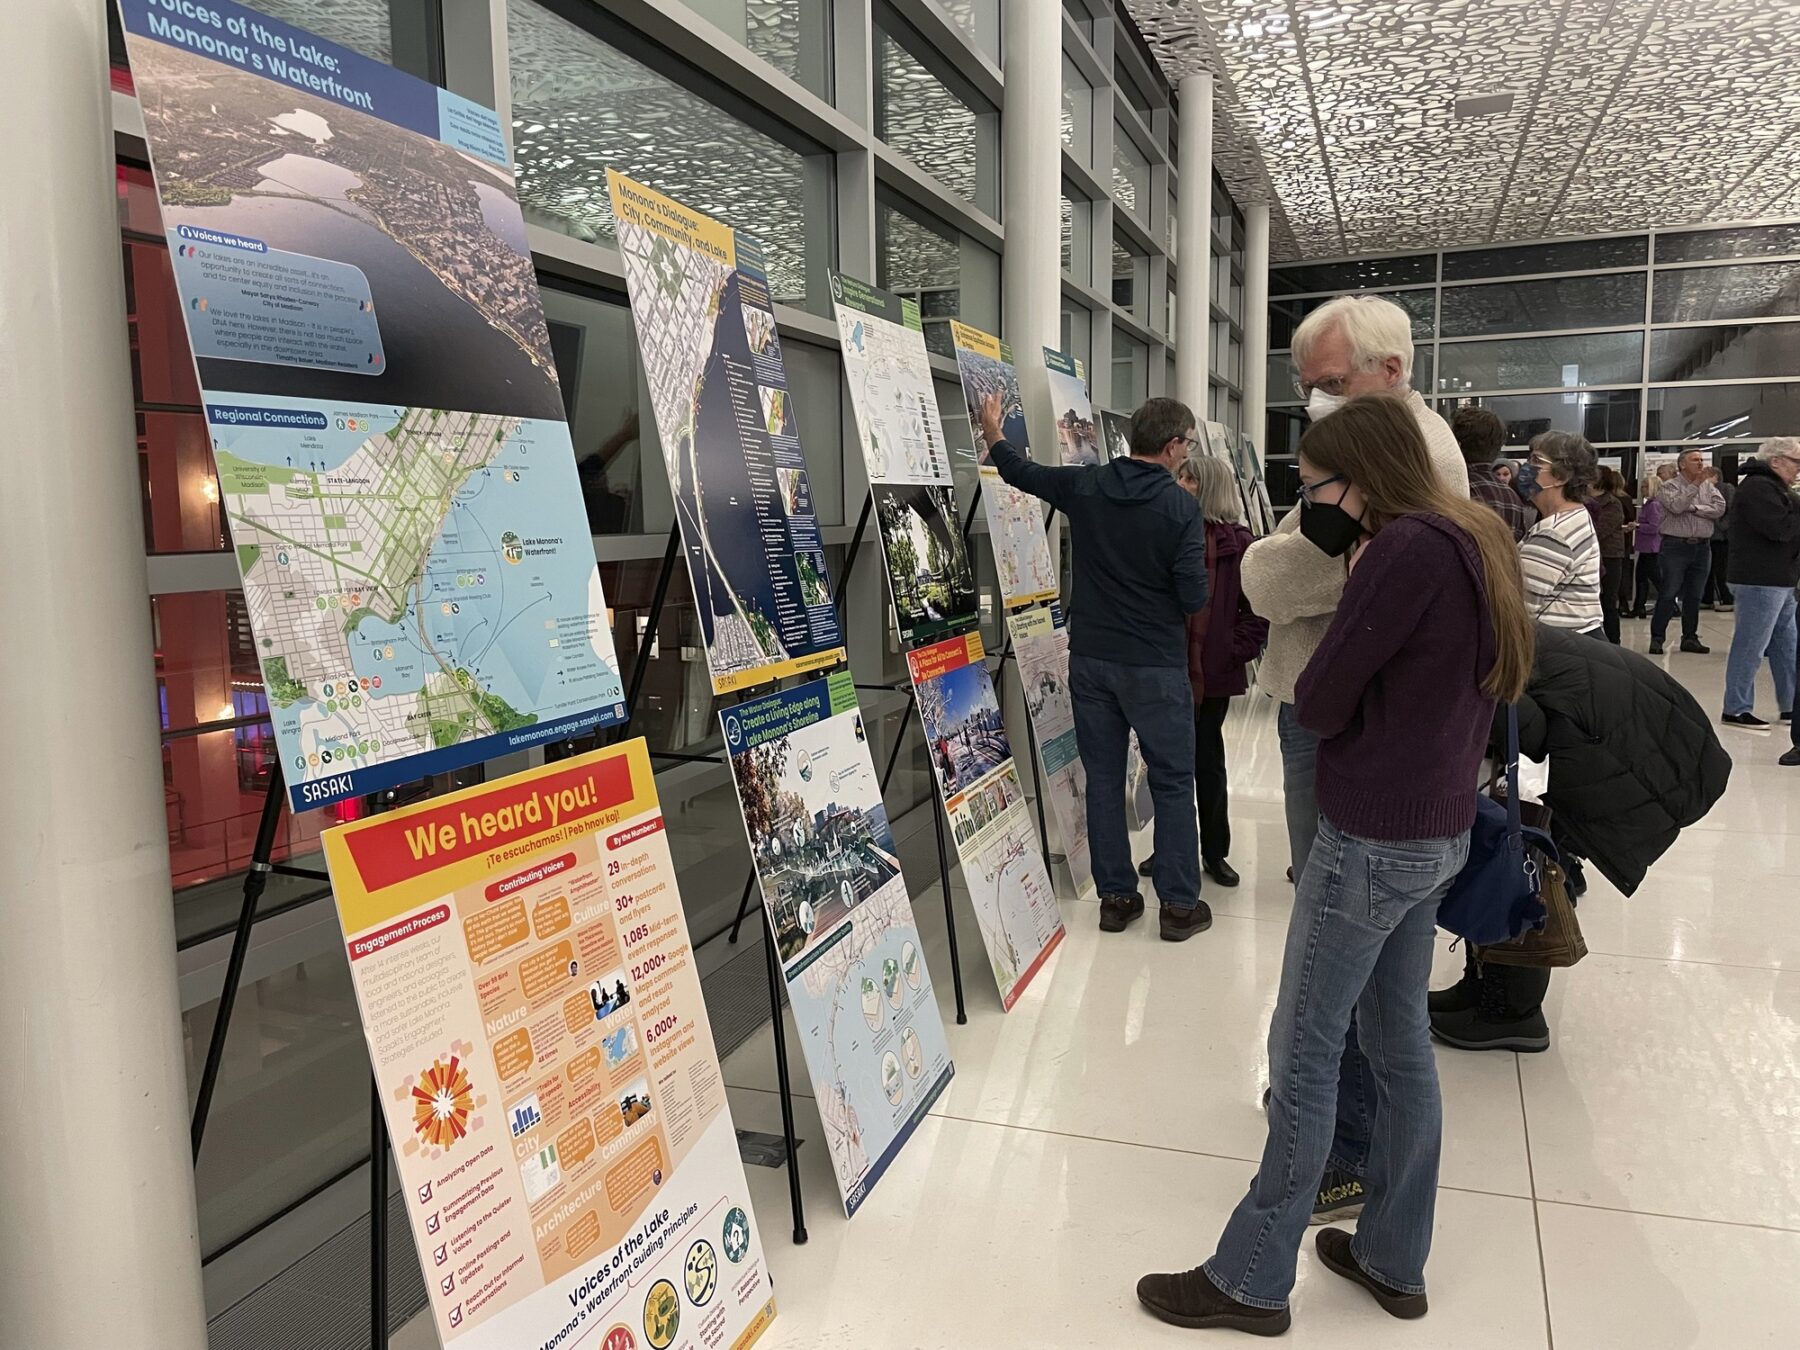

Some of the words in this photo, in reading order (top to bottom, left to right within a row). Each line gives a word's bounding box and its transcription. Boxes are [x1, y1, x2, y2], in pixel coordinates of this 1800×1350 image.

[148, 0, 222, 29] oices
[227, 17, 247, 37] of
[251, 23, 286, 53] the
[289, 38, 341, 73] Lake:
[147, 12, 263, 70] Monona's
[265, 54, 374, 111] Waterfront
[619, 183, 661, 214] Monona's
[191, 230, 222, 243] Voices
[223, 237, 237, 246] we
[238, 238, 263, 250] heard
[623, 203, 644, 225] City,
[645, 213, 695, 250] Community,
[696, 237, 709, 251] and
[710, 243, 728, 260] Lake
[215, 410, 261, 422] Regional
[264, 413, 325, 425] Connections
[509, 711, 614, 745] lakemonona.engage.sasaki.com
[742, 708, 765, 731] Create
[766, 715, 770, 723] a
[771, 706, 790, 721] Living
[789, 701, 803, 718] Edge
[804, 696, 820, 708] along
[746, 731, 762, 747] Lake
[762, 721, 793, 741] Monona's
[793, 712, 819, 730] Shoreline
[303, 775, 353, 802] SASAKI
[405, 823, 457, 860] We
[460, 792, 542, 844] heard
[544, 776, 598, 827] you!
[614, 838, 621, 846] By
[622, 833, 631, 841] the
[632, 822, 657, 838] Numbers!
[487, 852, 502, 870] ¡Te
[503, 832, 564, 860] escuchamos!
[568, 822, 584, 837] Peb
[585, 816, 604, 832] hnov
[605, 810, 620, 826] koj!
[499, 870, 543, 893] Contributing
[543, 860, 565, 874] Voices
[608, 861, 620, 876] 29
[621, 852, 649, 870] In-depth
[612, 862, 656, 889] conversations
[574, 900, 609, 924] Culture
[616, 895, 633, 911] 30+
[635, 882, 665, 904] postcards
[620, 913, 632, 925] and
[633, 904, 651, 920] flyers
[623, 924, 648, 948] 1,085
[650, 913, 678, 933] Mid-term
[355, 923, 412, 954] Engagement
[412, 910, 445, 928] Process
[628, 946, 645, 960] event
[646, 927, 677, 953] responses
[631, 953, 666, 981] 12,000+
[668, 944, 689, 960] Google
[635, 980, 653, 996] Maps
[654, 960, 686, 984] comments
[639, 993, 651, 1008] and
[652, 981, 673, 1000] results
[642, 997, 671, 1022] analyzed
[487, 1006, 527, 1035] Nature
[604, 1005, 633, 1029] Water
[646, 1014, 678, 1043] 6,000+
[650, 1029, 682, 1057] Instagram
[682, 1020, 694, 1035] and
[654, 1048, 678, 1070] website
[678, 1036, 694, 1054] views
[569, 1082, 600, 1108] Accessibility
[516, 1134, 539, 1157] City
[602, 1111, 658, 1160] Community
[437, 1164, 465, 1187] Analyzing
[465, 1154, 481, 1168] Open
[480, 1145, 494, 1158] Data
[443, 1182, 481, 1213] Summarizing
[481, 1167, 504, 1187] Previous
[445, 1194, 479, 1223] Engagement
[479, 1184, 494, 1198] Data
[451, 1224, 476, 1246] Listening
[477, 1219, 482, 1227] to
[483, 1212, 492, 1223] the
[493, 1196, 512, 1217] Quieter
[535, 1181, 602, 1242] Architecture
[453, 1238, 472, 1255] Voices
[458, 1258, 476, 1275] Online
[477, 1241, 500, 1264] Postings
[501, 1230, 511, 1243] and
[568, 1261, 611, 1307] Voices
[612, 1248, 624, 1268] of
[625, 1232, 643, 1256] the
[644, 1208, 670, 1238] Lake
[586, 1264, 633, 1314] Waterfront
[633, 1237, 663, 1269] Guiding
[663, 1202, 698, 1241] Principles
[460, 1263, 484, 1285] Updates
[466, 1290, 484, 1306] Reach
[484, 1282, 494, 1292] Out
[502, 1254, 524, 1277] Informal
[468, 1281, 507, 1316] Conversations
